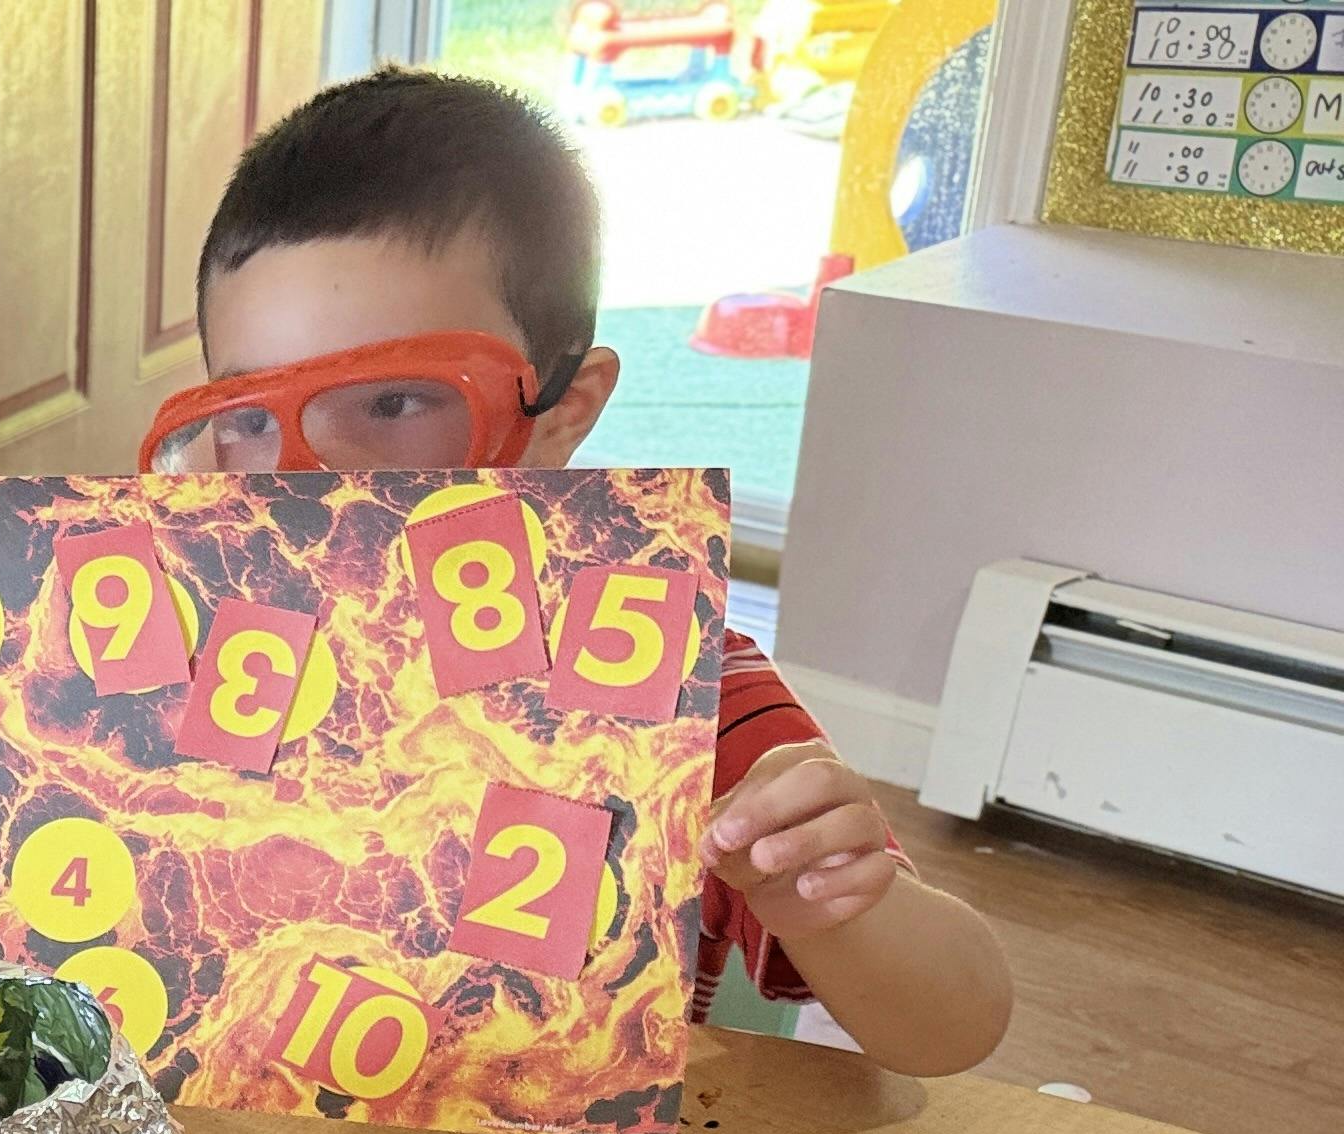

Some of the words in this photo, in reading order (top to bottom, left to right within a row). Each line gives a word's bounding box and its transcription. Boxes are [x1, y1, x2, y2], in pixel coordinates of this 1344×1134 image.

[71, 555, 153, 661] 9
[432, 540, 525, 651] 8
[573, 573, 669, 687] 5
[51, 857, 91, 907] 4
[462, 824, 567, 940] 2
[281, 961, 428, 1100] 10
